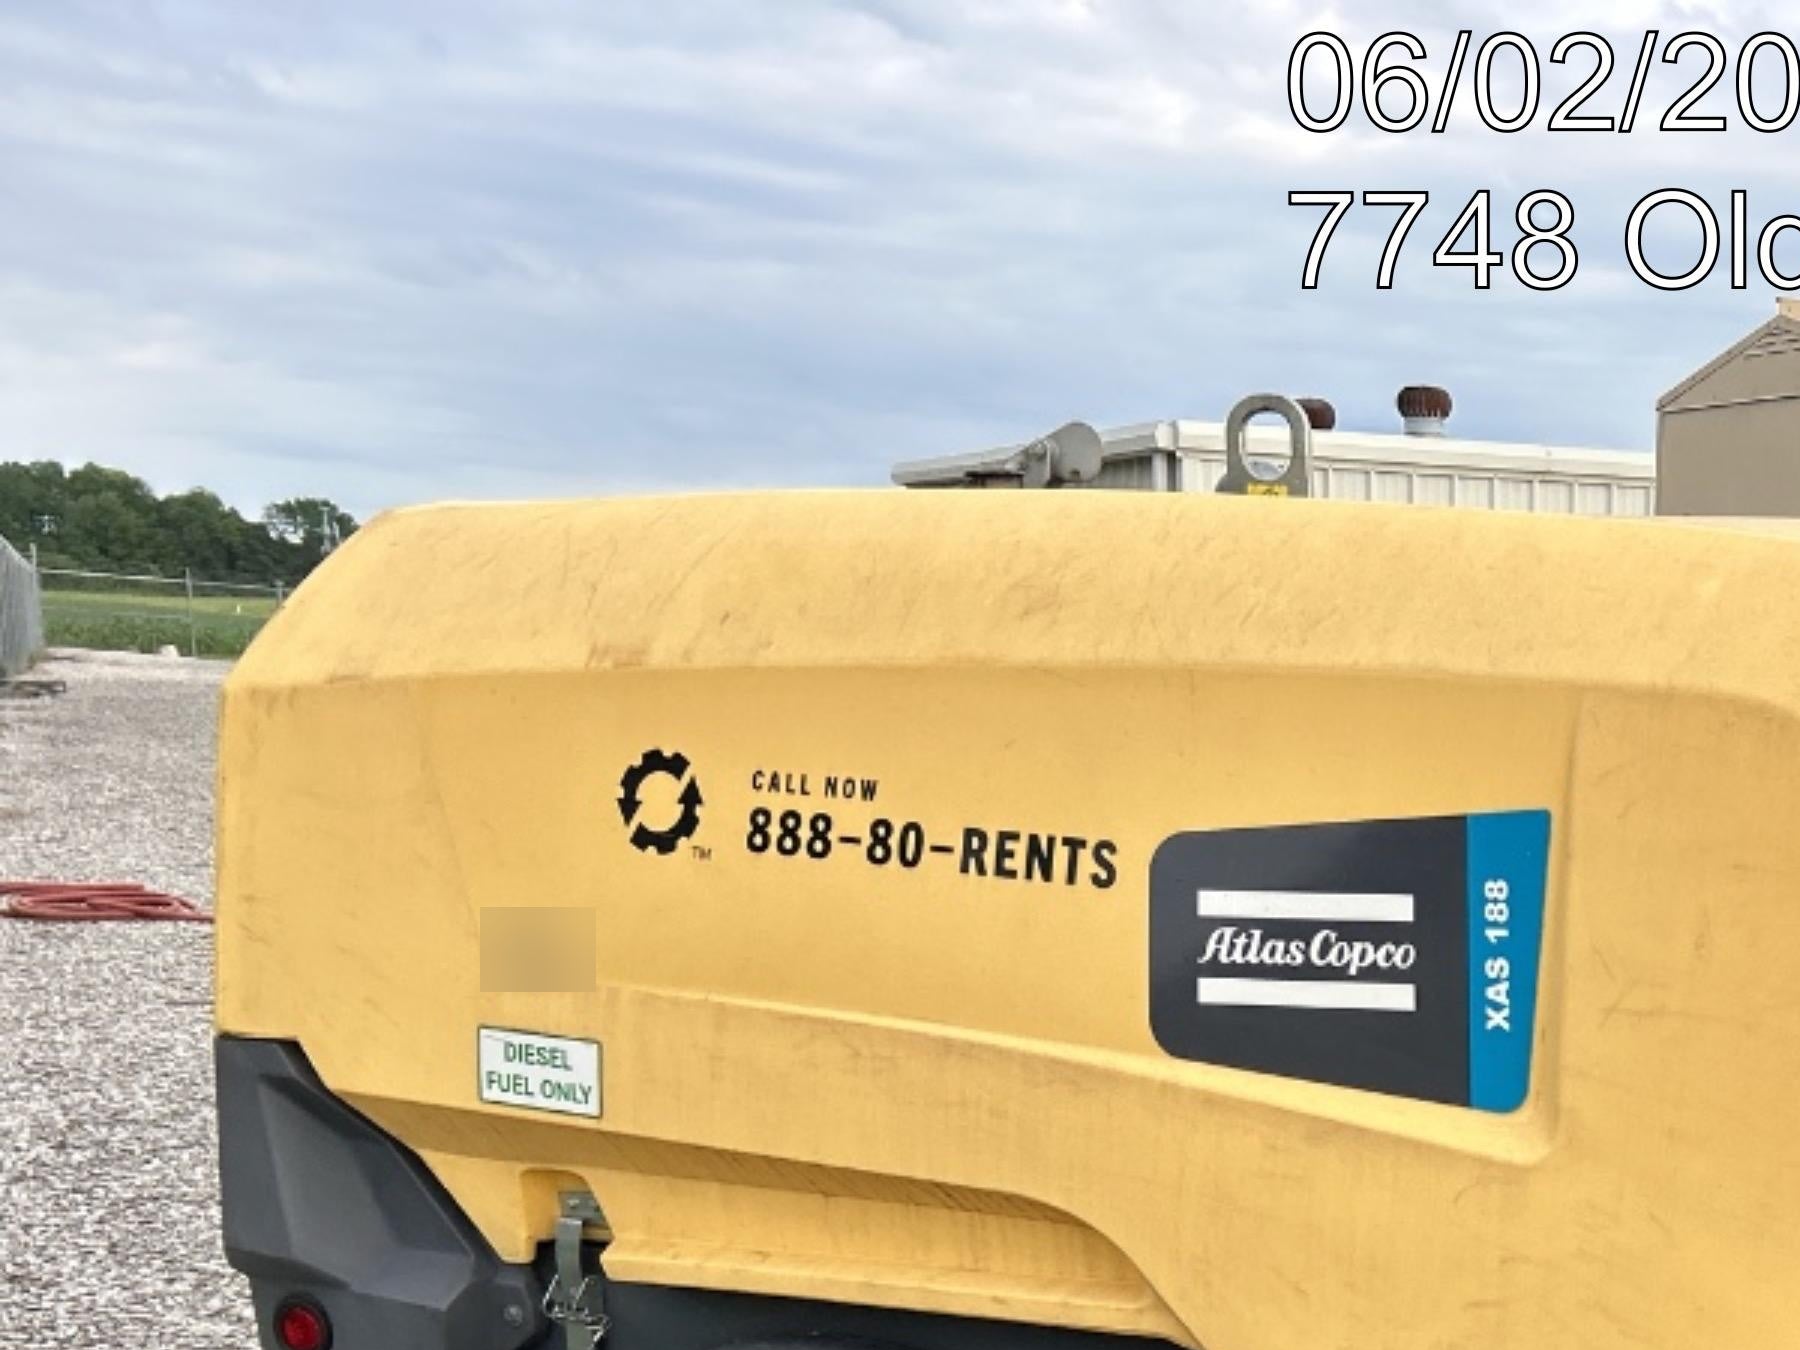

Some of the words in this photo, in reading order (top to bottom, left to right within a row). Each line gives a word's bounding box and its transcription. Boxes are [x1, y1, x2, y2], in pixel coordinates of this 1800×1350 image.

[752, 770, 811, 796] CALL
[824, 776, 879, 802] NOW
[746, 806, 1118, 889] 888-80-RENTS
[1484, 878, 1510, 944] 188
[1484, 956, 1511, 1032] XAS
[503, 1040, 574, 1072] DIESEL
[485, 1070, 535, 1097] FUEL
[540, 1079, 592, 1105] ONLY
